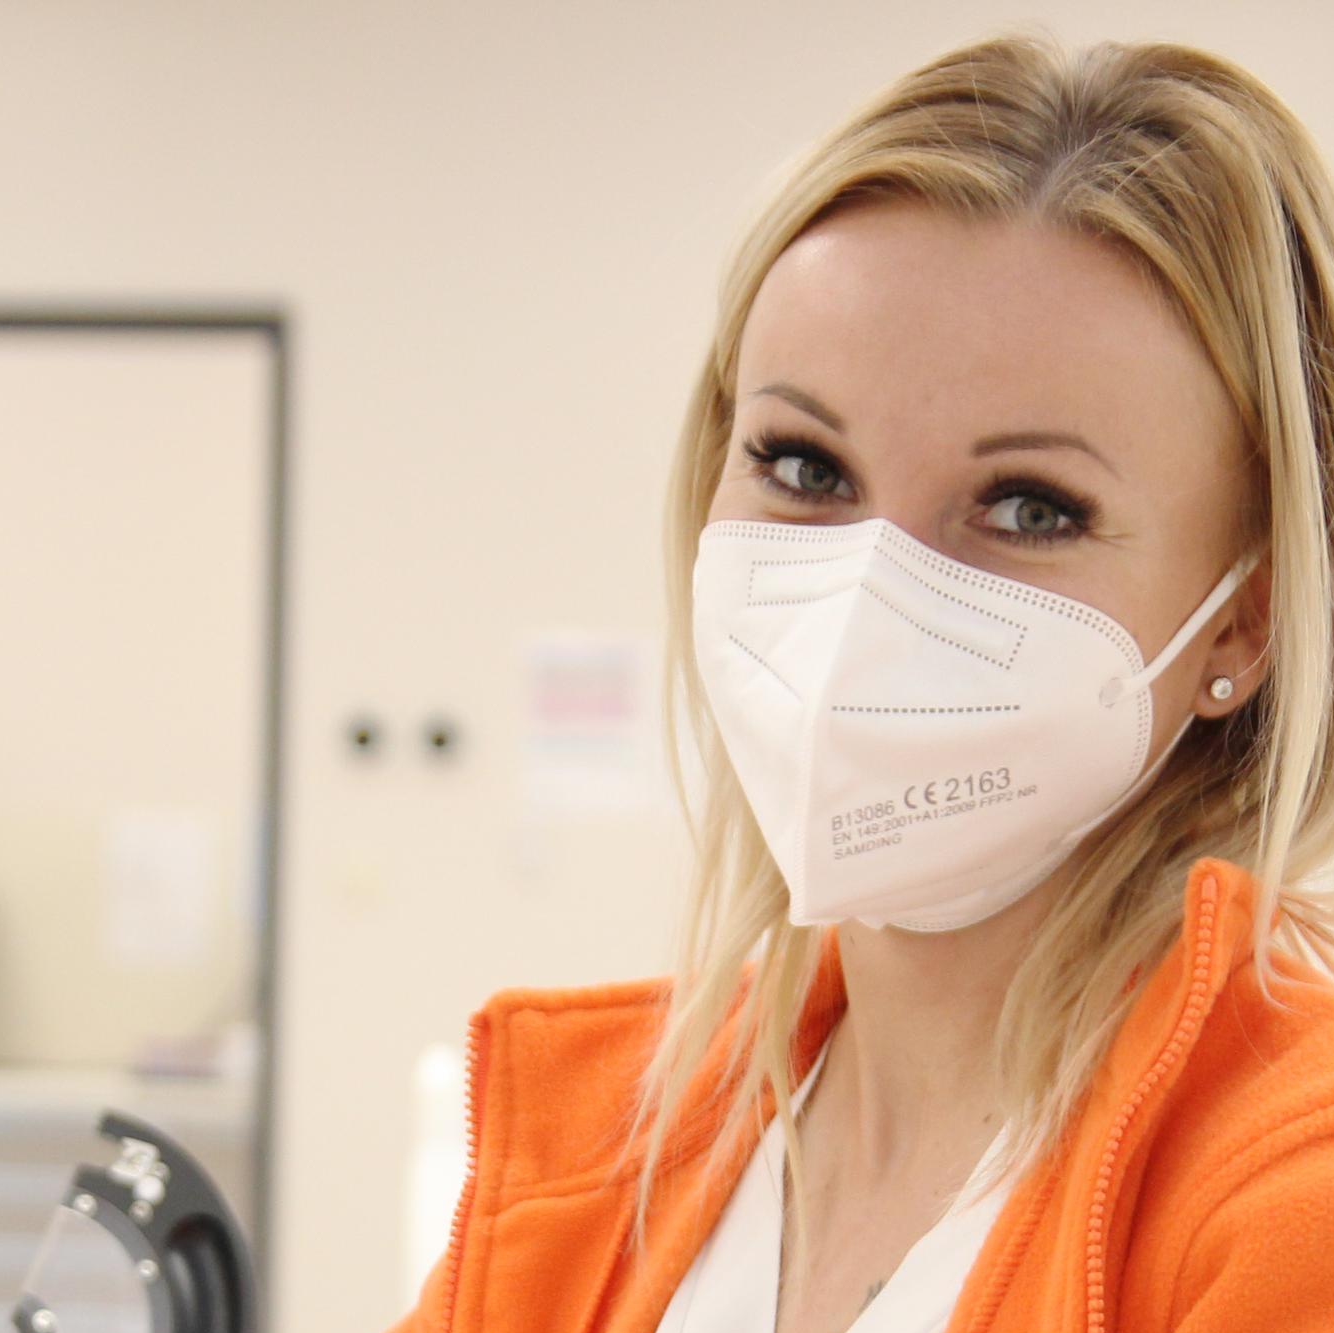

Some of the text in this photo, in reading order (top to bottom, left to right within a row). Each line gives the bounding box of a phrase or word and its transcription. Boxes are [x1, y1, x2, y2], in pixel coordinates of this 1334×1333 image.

[831, 801, 895, 831] B13086
[944, 768, 1011, 801] 2163
[833, 833, 852, 845] EN
[979, 792, 1014, 808] FFP2
[1017, 785, 1038, 799] NR
[834, 833, 902, 860] SAMDING
